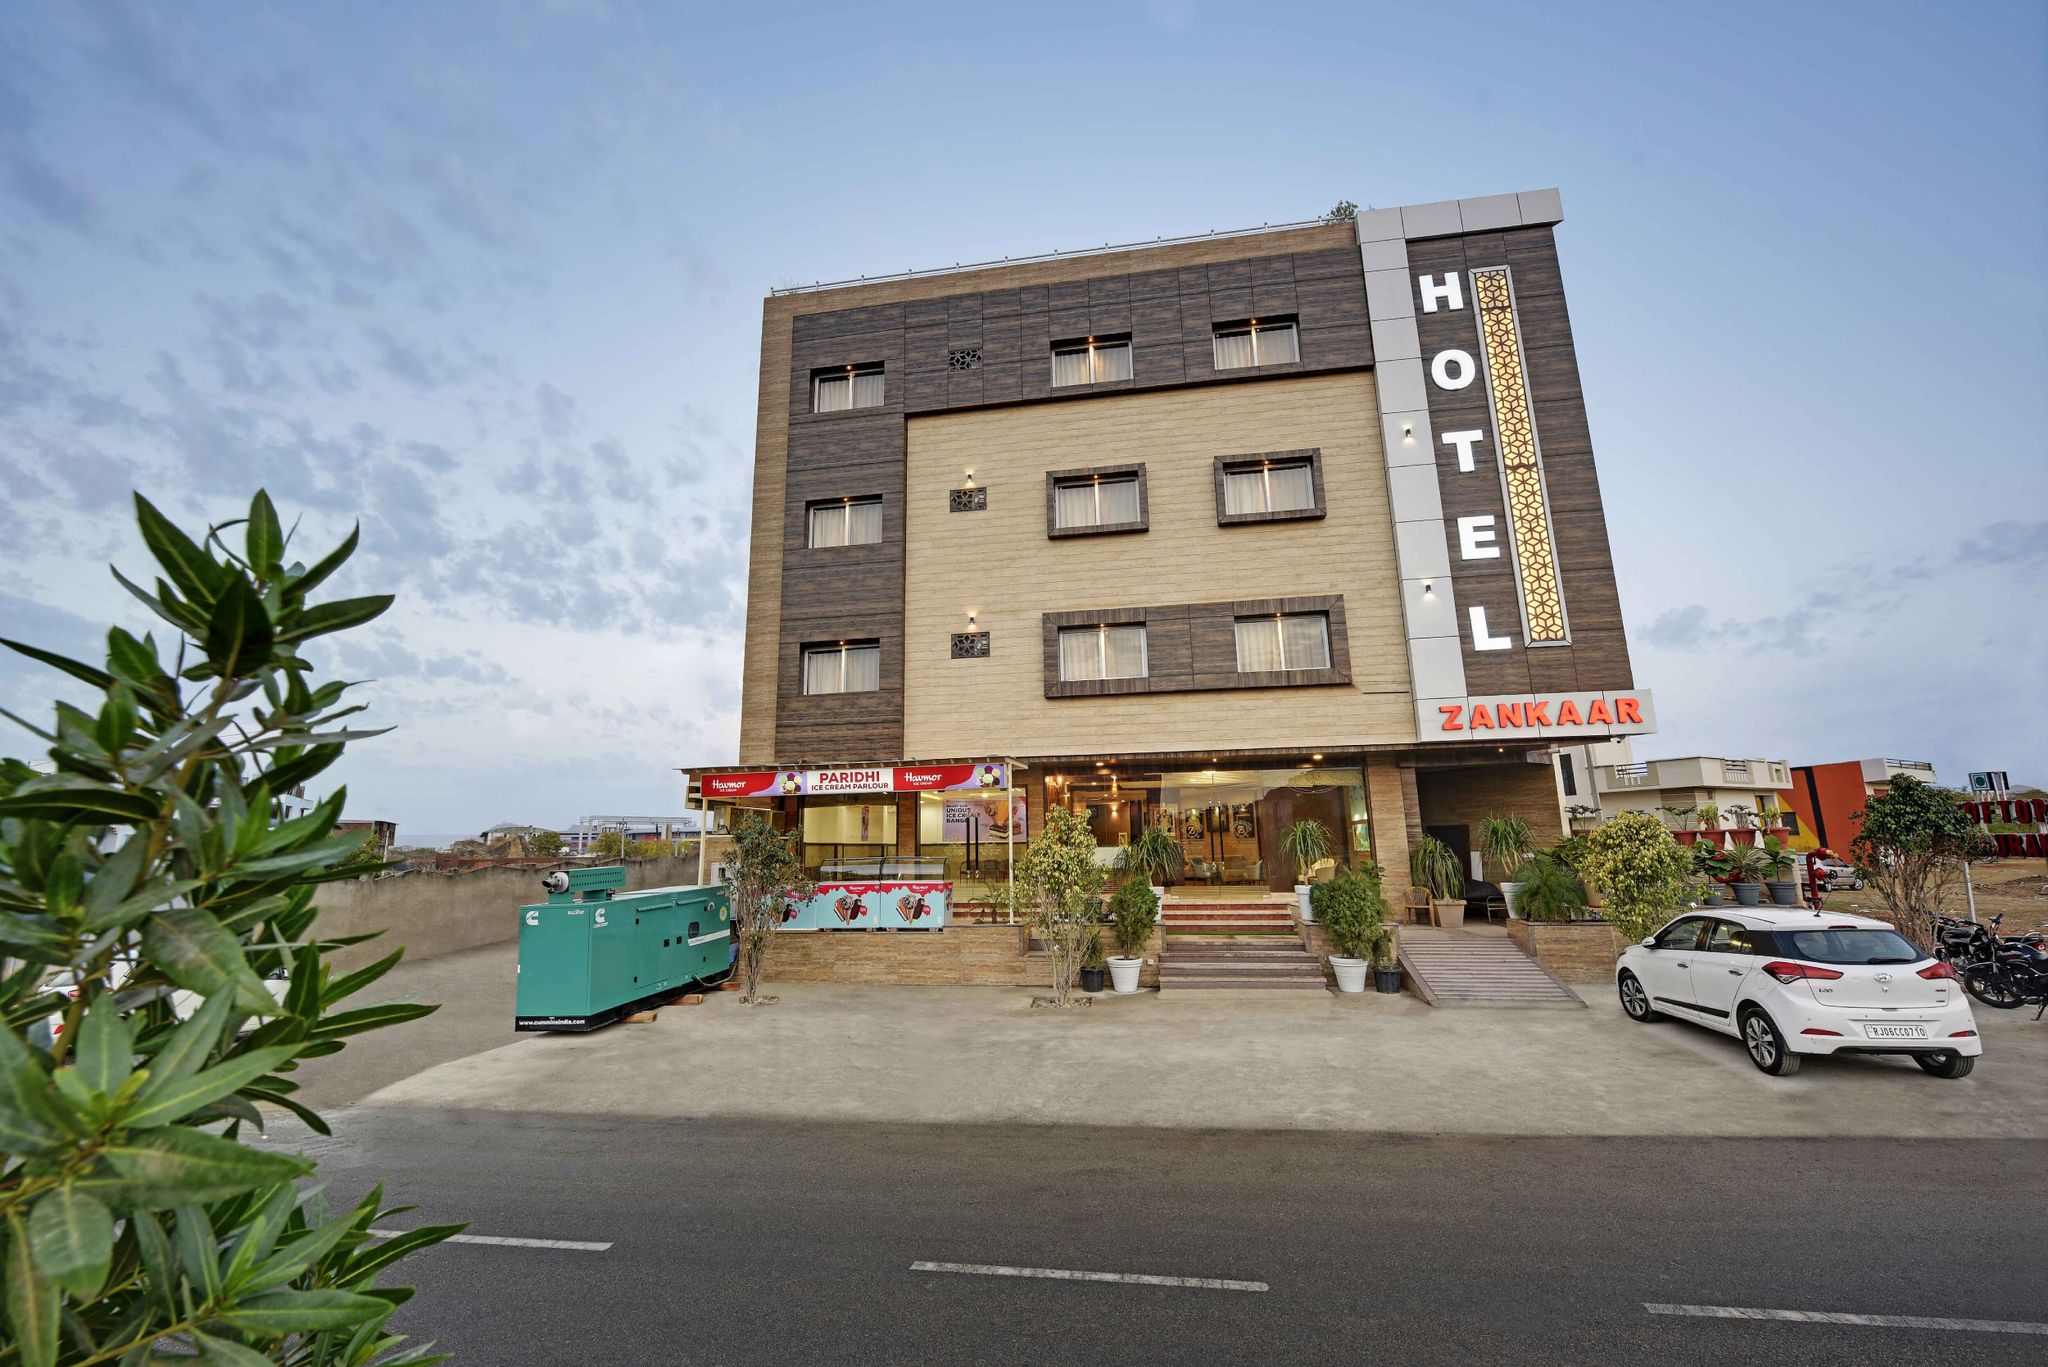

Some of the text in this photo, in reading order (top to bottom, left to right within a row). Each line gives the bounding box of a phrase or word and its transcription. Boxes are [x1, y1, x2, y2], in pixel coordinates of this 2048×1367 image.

[1418, 271, 1512, 652] HOTEL
[1439, 697, 1644, 731] ZANKAAR
[819, 771, 880, 784] PARIDHI
[904, 772, 942, 782] Havmor
[711, 780, 746, 789] Havmor
[1872, 1027, 1926, 1037] RJ06CC0710
